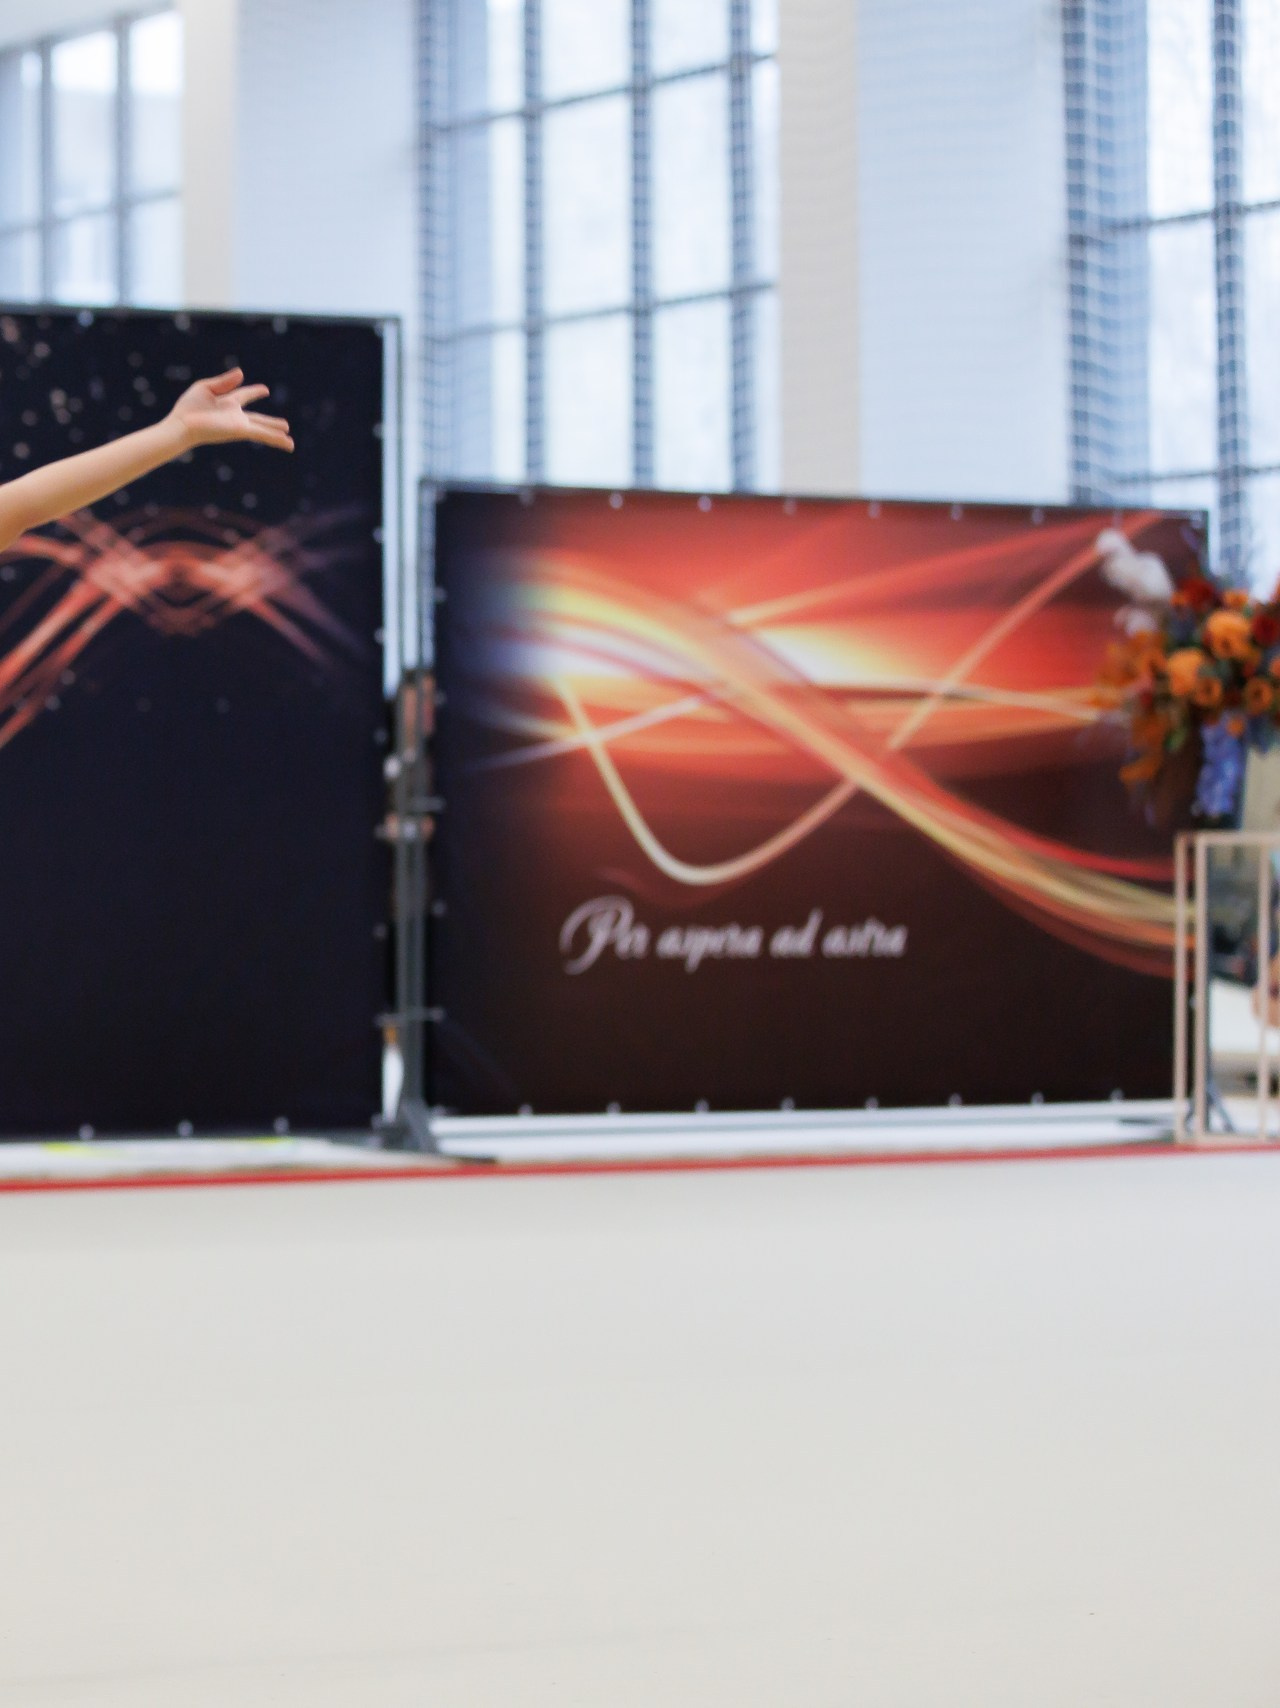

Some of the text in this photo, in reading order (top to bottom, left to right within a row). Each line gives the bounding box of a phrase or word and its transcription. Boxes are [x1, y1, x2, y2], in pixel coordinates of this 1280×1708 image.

[559, 895, 907, 975] Per aspera ad astra
